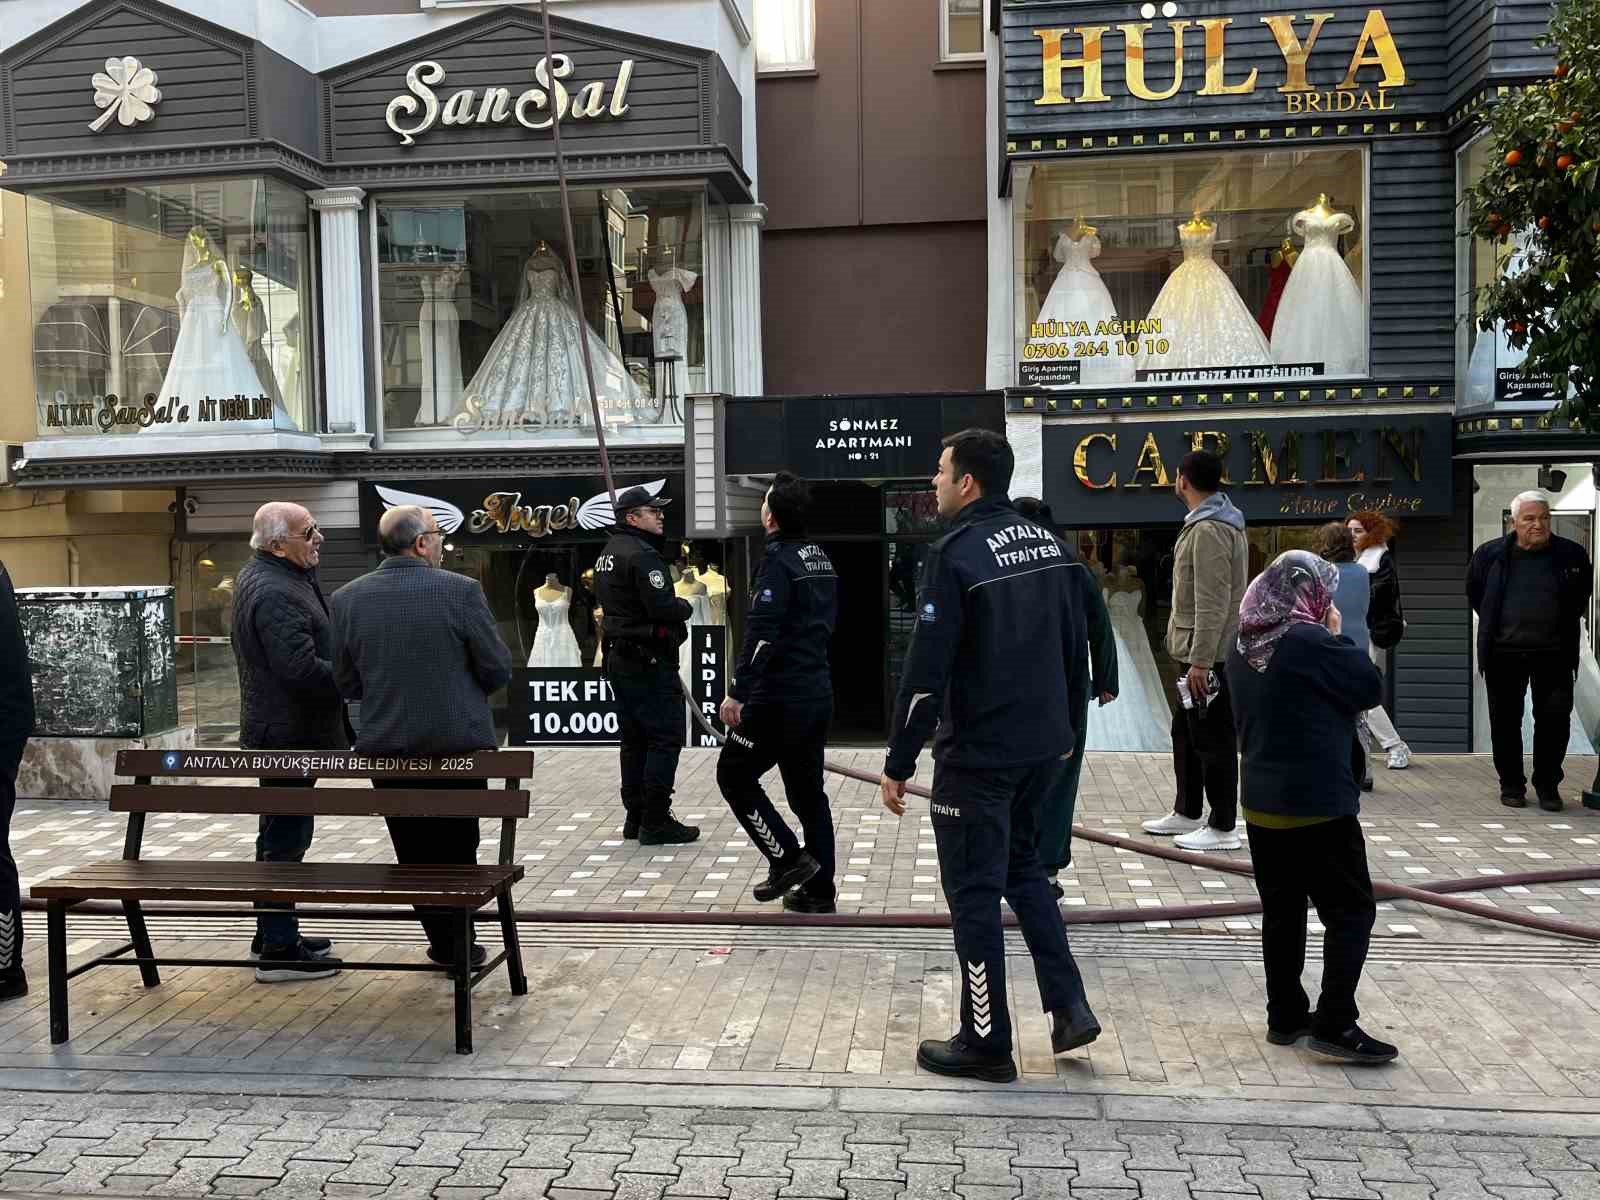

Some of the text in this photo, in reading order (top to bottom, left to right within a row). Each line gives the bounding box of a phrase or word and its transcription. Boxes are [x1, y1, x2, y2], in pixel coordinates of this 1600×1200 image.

[1033, 2, 1407, 105] HÜLYA
[386, 53, 634, 145] ŞanSal
[1286, 89, 1395, 114] BRIDAL
[1031, 315, 1162, 338] HÜLYA AĞHAN
[1023, 338, 1170, 359] 0506 264 10 10
[1021, 365, 1078, 374] Giriş Apartman
[1028, 373, 1071, 382] Kapısından
[47, 404, 69, 426] ALT
[70, 403, 94, 425] KAT
[198, 396, 217, 421] AİT
[219, 394, 272, 421] DEĞİLDİR
[829, 418, 898, 431] SÖNMEZ
[815, 436, 912, 448] APARTMANI
[848, 452, 862, 460] NO
[869, 452, 879, 460] 21
[470, 492, 580, 538] Angel
[986, 525, 1055, 552] ANTALYA
[594, 554, 614, 572] OLİS
[994, 543, 1061, 567] İTFAİYESİ
[529, 681, 578, 702] TEK
[701, 633, 718, 747] İNDİRİM
[529, 712, 620, 734] 10.000
[184, 755, 474, 776] ANTALYA BÜYÜKŞEHİR BELEDİYESİ 2025
